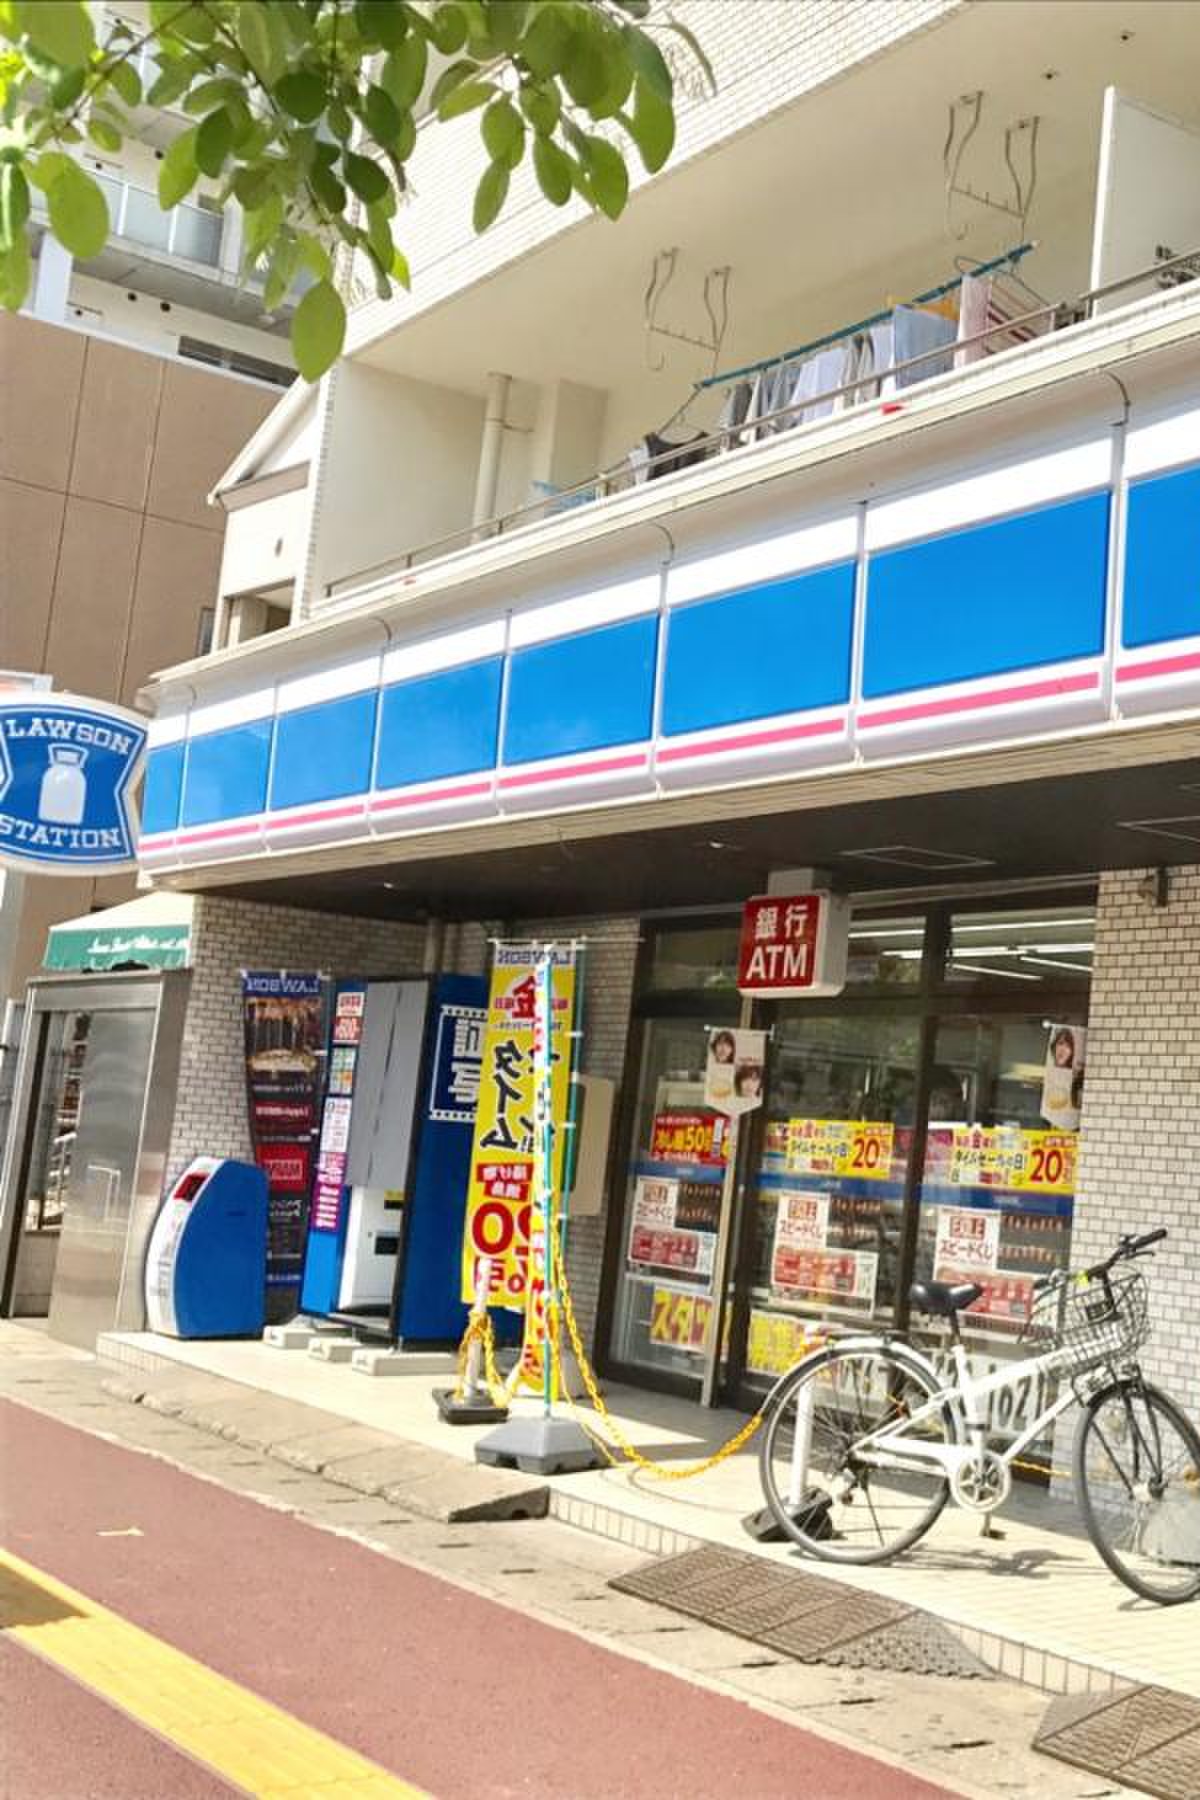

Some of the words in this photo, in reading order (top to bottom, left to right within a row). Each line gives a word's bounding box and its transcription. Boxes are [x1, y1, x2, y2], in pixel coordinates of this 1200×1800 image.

[6, 719, 131, 755] LAWSON
[0, 814, 122, 848] STATION
[755, 904, 808, 941] 銀行
[745, 943, 808, 980] ATM
